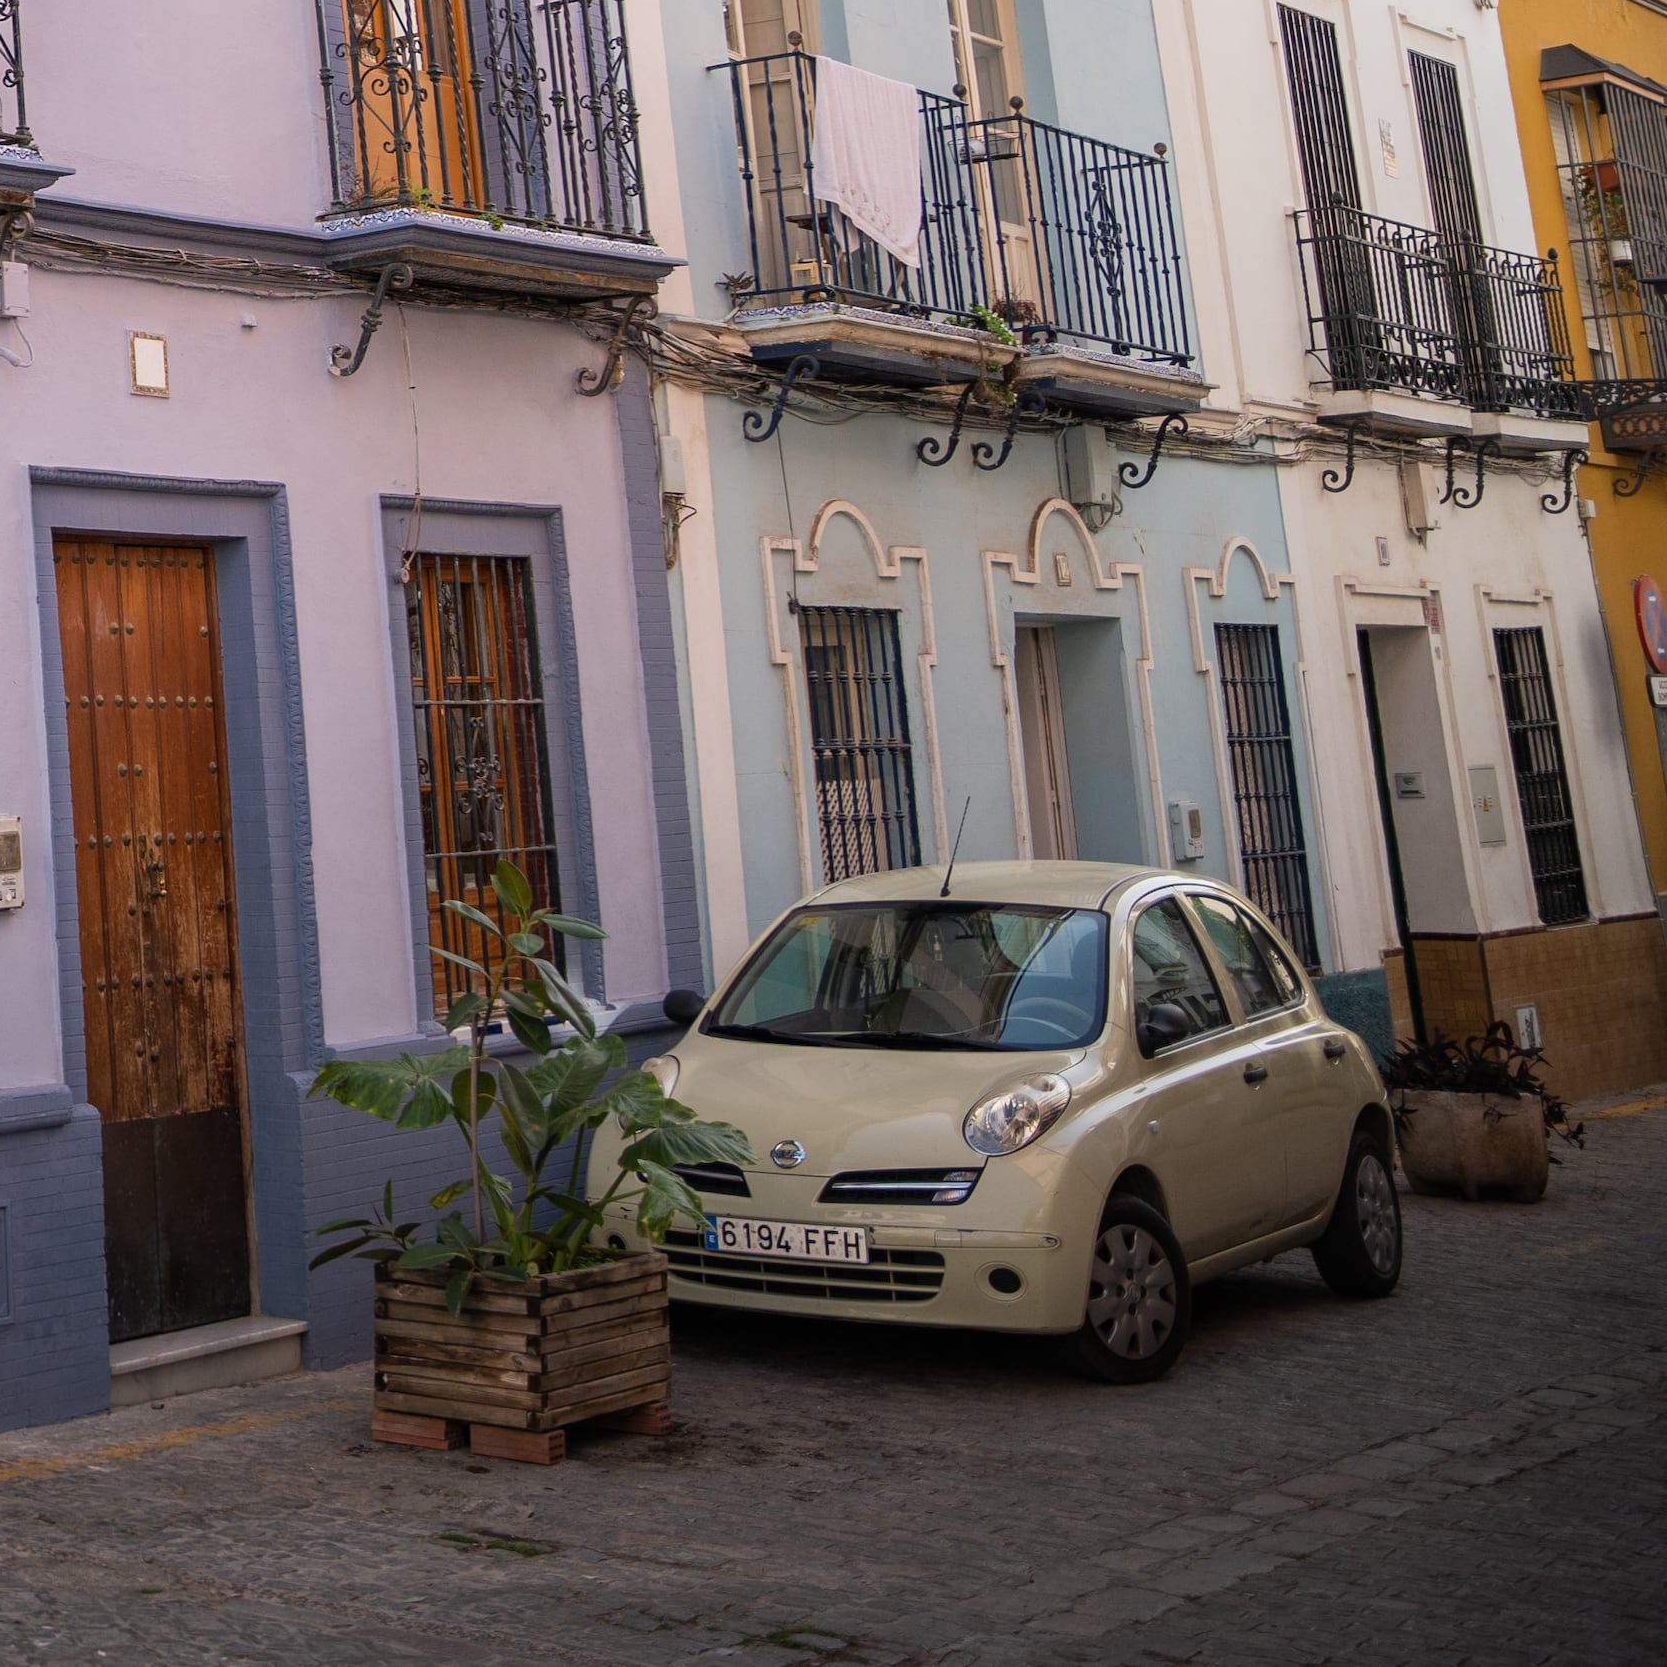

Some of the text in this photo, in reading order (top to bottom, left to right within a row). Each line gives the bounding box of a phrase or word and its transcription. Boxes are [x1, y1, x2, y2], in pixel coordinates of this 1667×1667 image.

[709, 1235, 716, 1243] E
[721, 1221, 860, 1260] 6194 FFH
